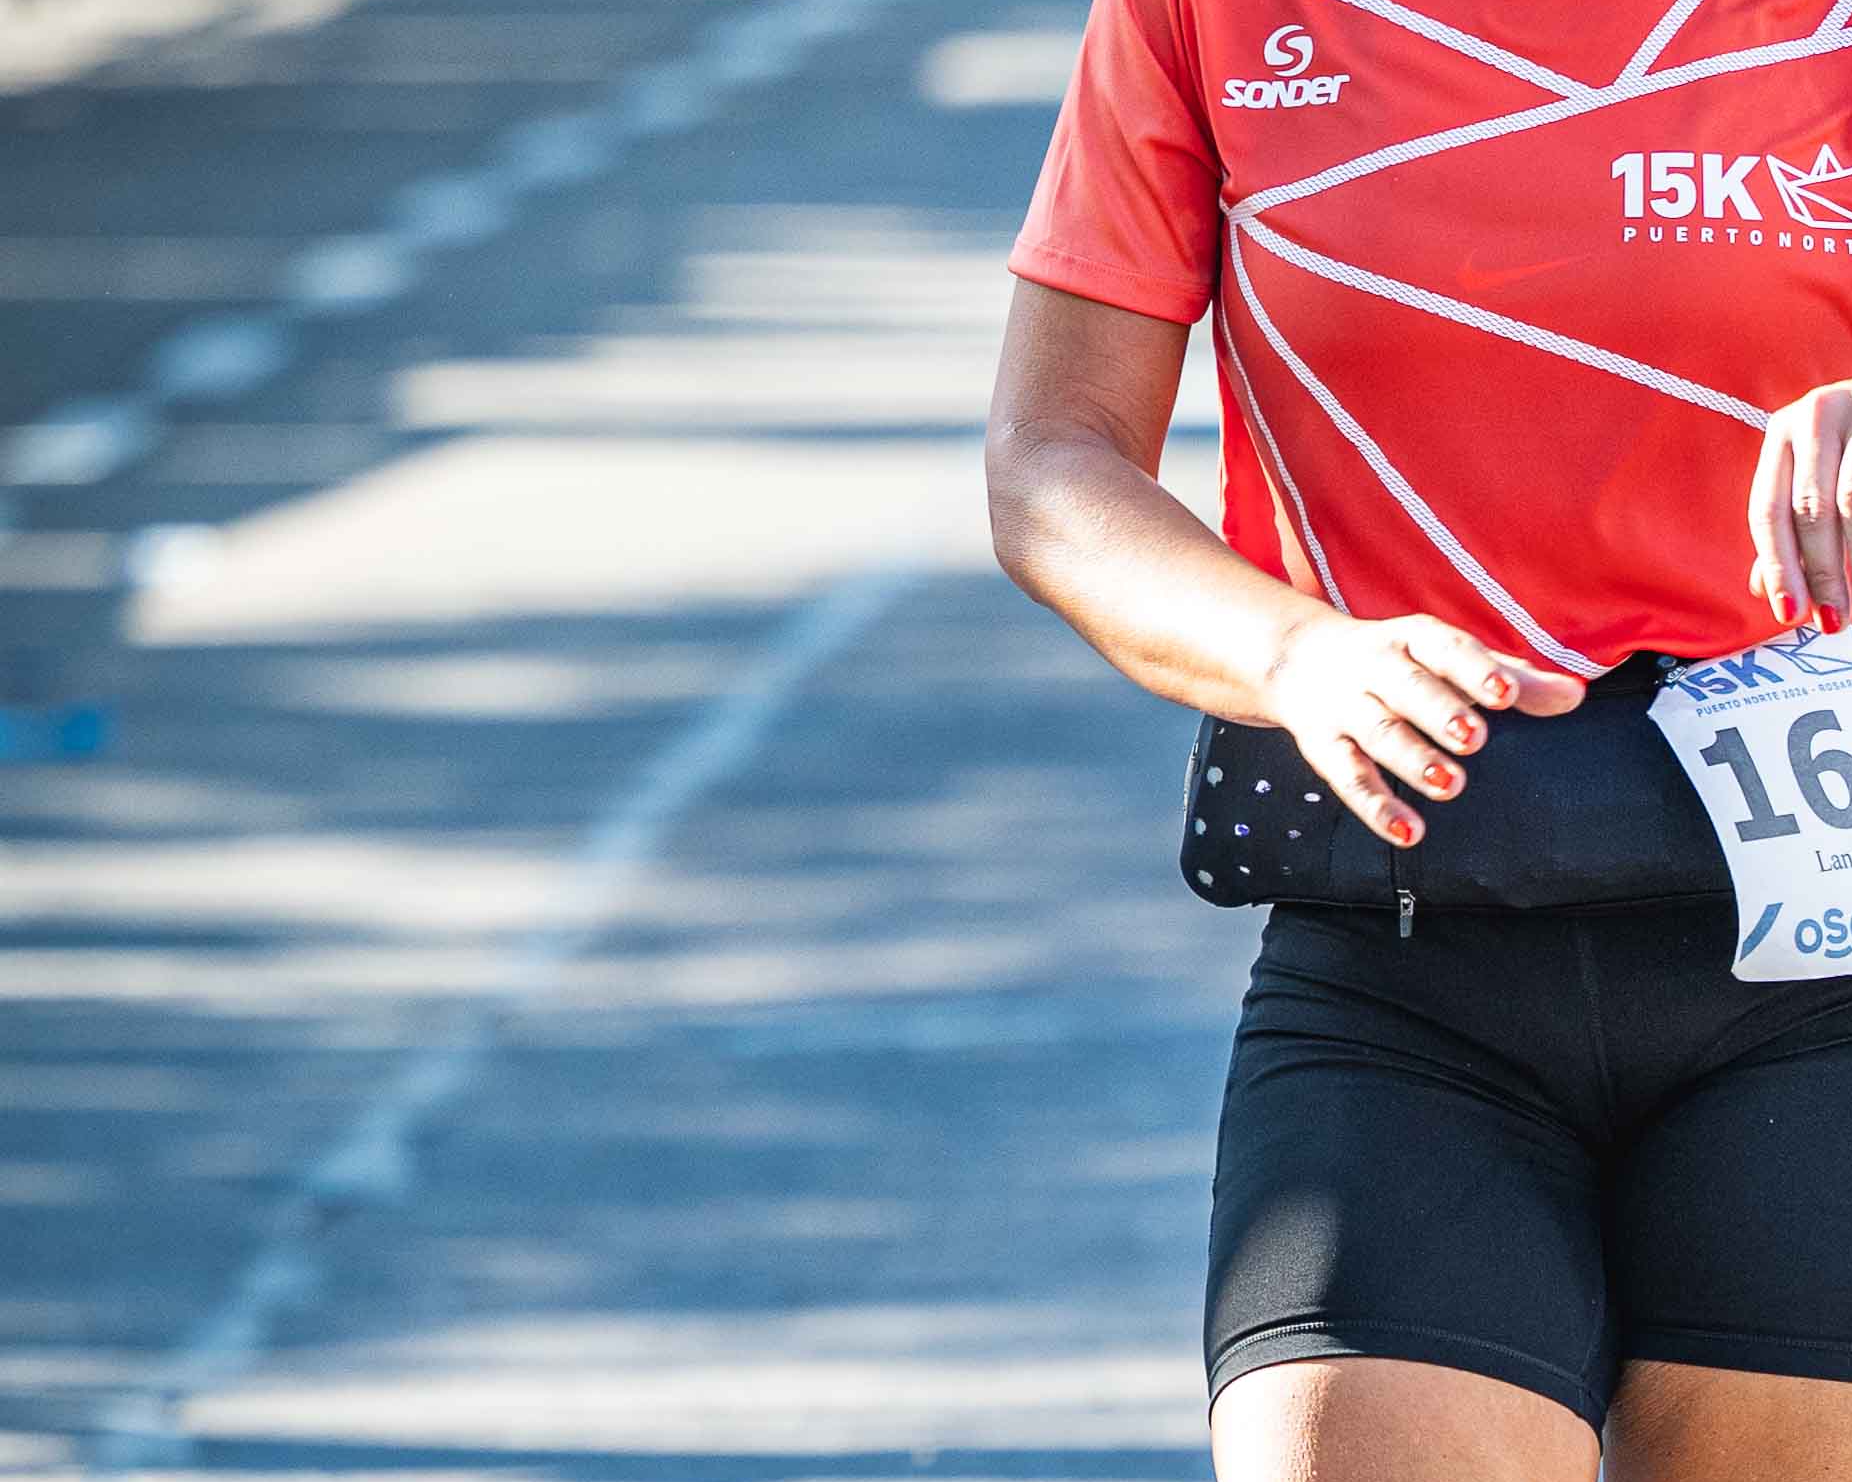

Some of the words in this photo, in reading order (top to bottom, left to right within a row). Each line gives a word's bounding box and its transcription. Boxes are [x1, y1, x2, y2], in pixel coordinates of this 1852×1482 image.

[1611, 152, 1763, 220] 15K
[1623, 226, 1763, 246] PUERTO
[1679, 650, 1784, 701] 15K
[1696, 699, 1741, 718] PUERTO
[1744, 691, 1780, 705] NORTE
